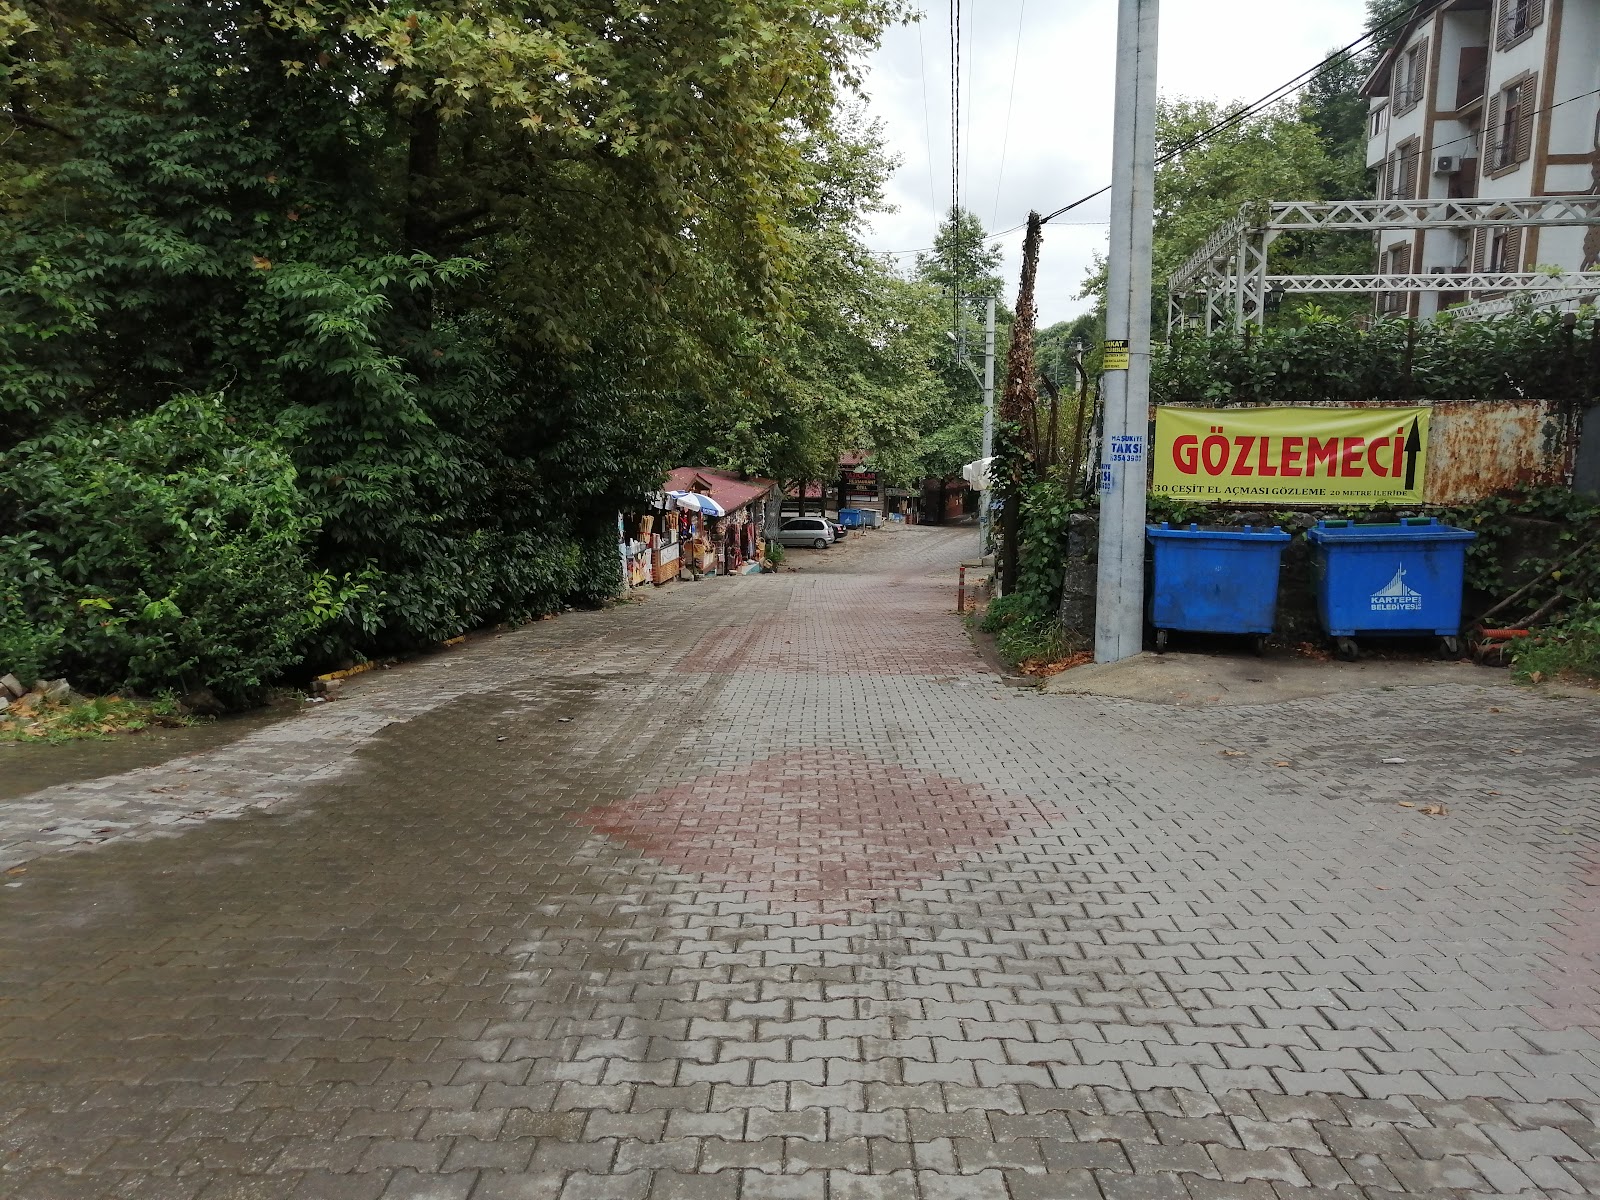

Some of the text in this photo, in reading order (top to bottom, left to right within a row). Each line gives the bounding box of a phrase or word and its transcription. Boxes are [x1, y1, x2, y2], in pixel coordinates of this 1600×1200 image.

[1111, 443, 1142, 454] TAKSİ
[1172, 426, 1405, 477] GÖZLEMECİ
[1154, 484, 1169, 493] 30
[1171, 483, 1205, 495] ÇEŞİT
[1207, 485, 1222, 494] EL
[1224, 486, 1269, 496] AÇMASI
[1271, 486, 1327, 496] GÖZLEME
[1373, 489, 1408, 497] İLERİDE
